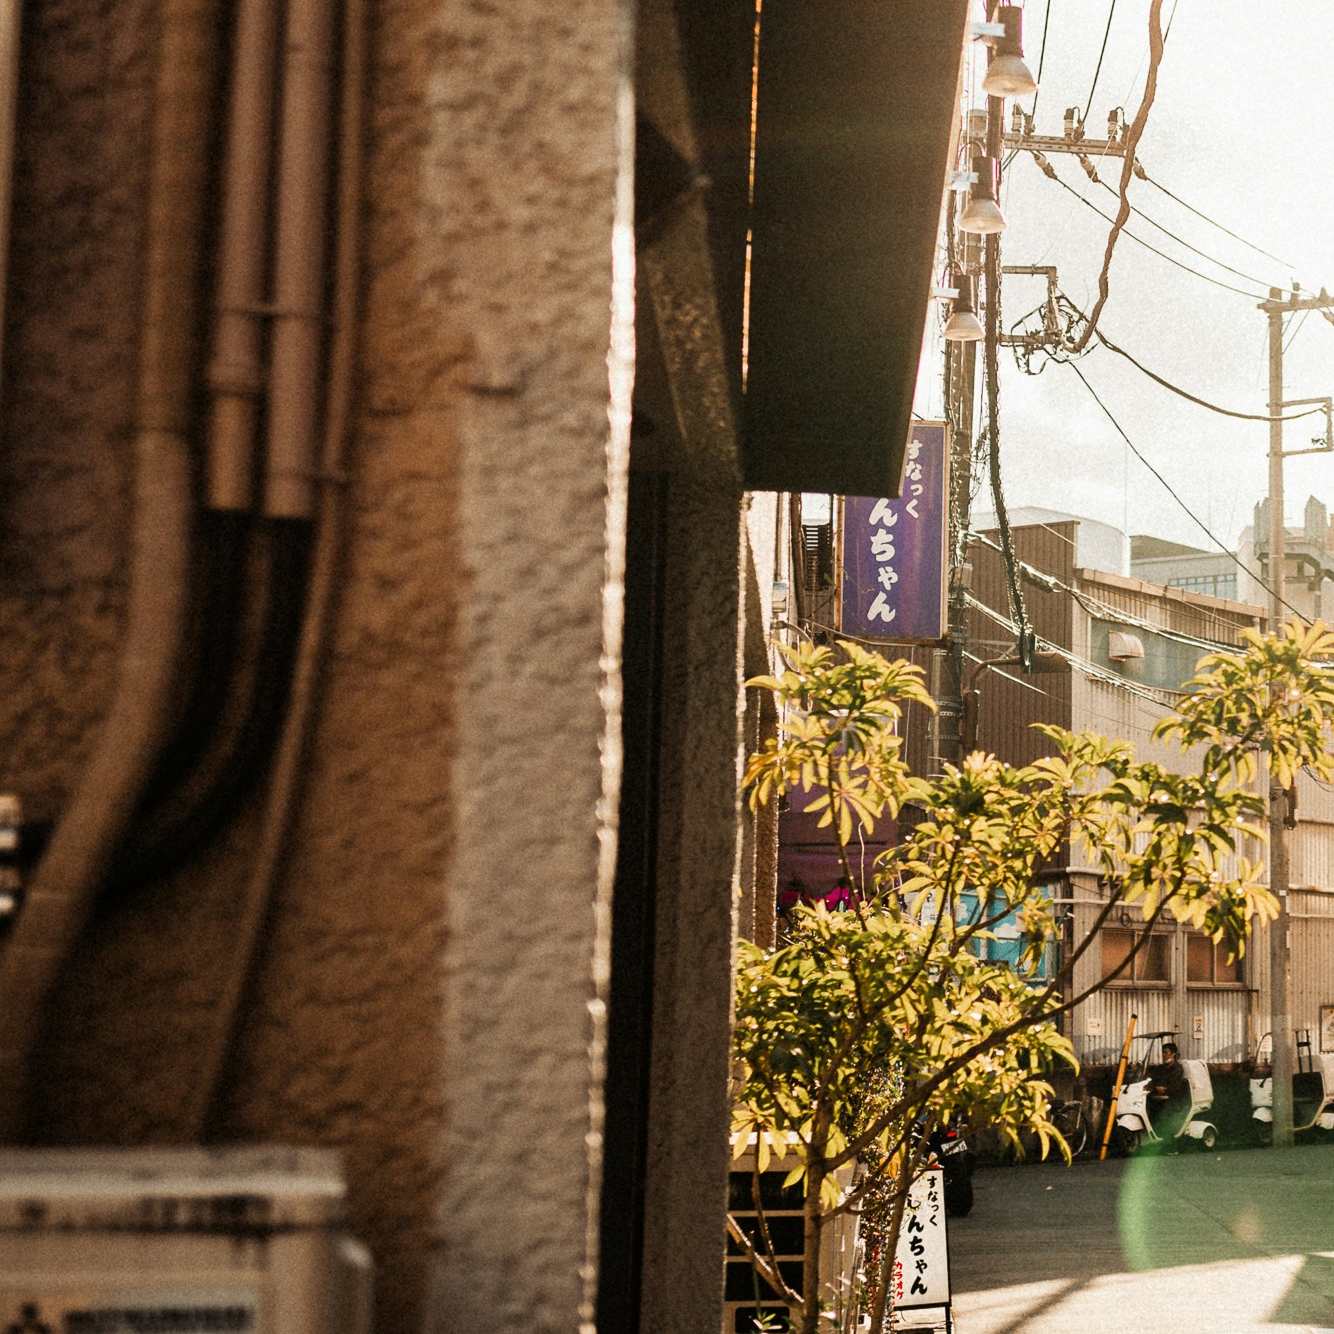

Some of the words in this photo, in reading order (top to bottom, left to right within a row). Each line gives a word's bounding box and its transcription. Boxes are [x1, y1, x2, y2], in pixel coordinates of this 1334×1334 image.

[905, 439, 923, 519] すなっく
[867, 498, 898, 623] んちゃん
[927, 1175, 940, 1227] すなっく
[895, 1261, 905, 1299] カラオケ
